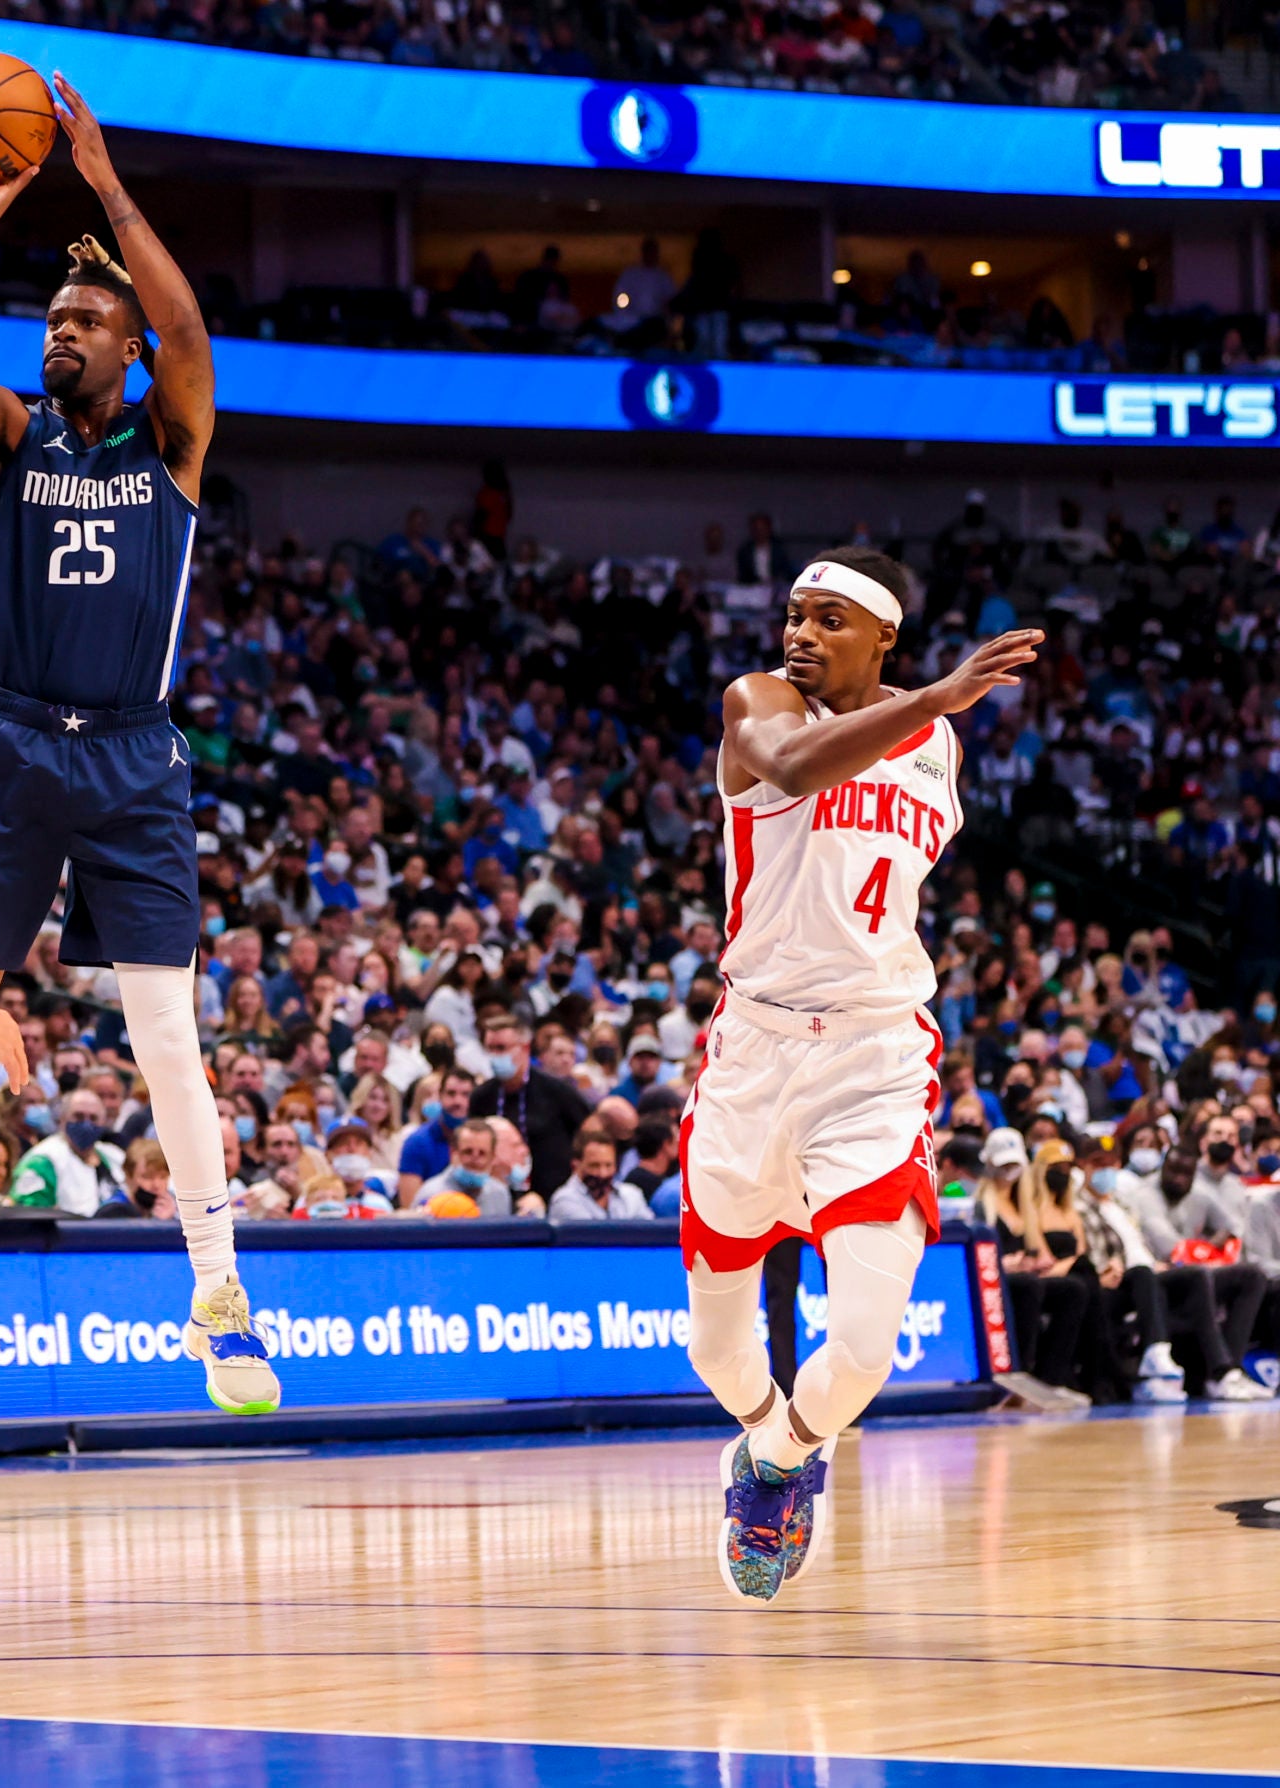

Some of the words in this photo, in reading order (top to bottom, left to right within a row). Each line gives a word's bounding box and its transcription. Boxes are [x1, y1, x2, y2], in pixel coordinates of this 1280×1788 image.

[1055, 380, 1277, 438] LET'S
[22, 470, 153, 510] MAVERICKS
[48, 519, 116, 585] 25
[913, 759, 946, 782] MONEY
[811, 780, 945, 864] ROCKETS
[853, 857, 892, 934] 4
[362, 1305, 402, 1356] of
[408, 1304, 469, 1355] the
[476, 1302, 592, 1354] Dallas
